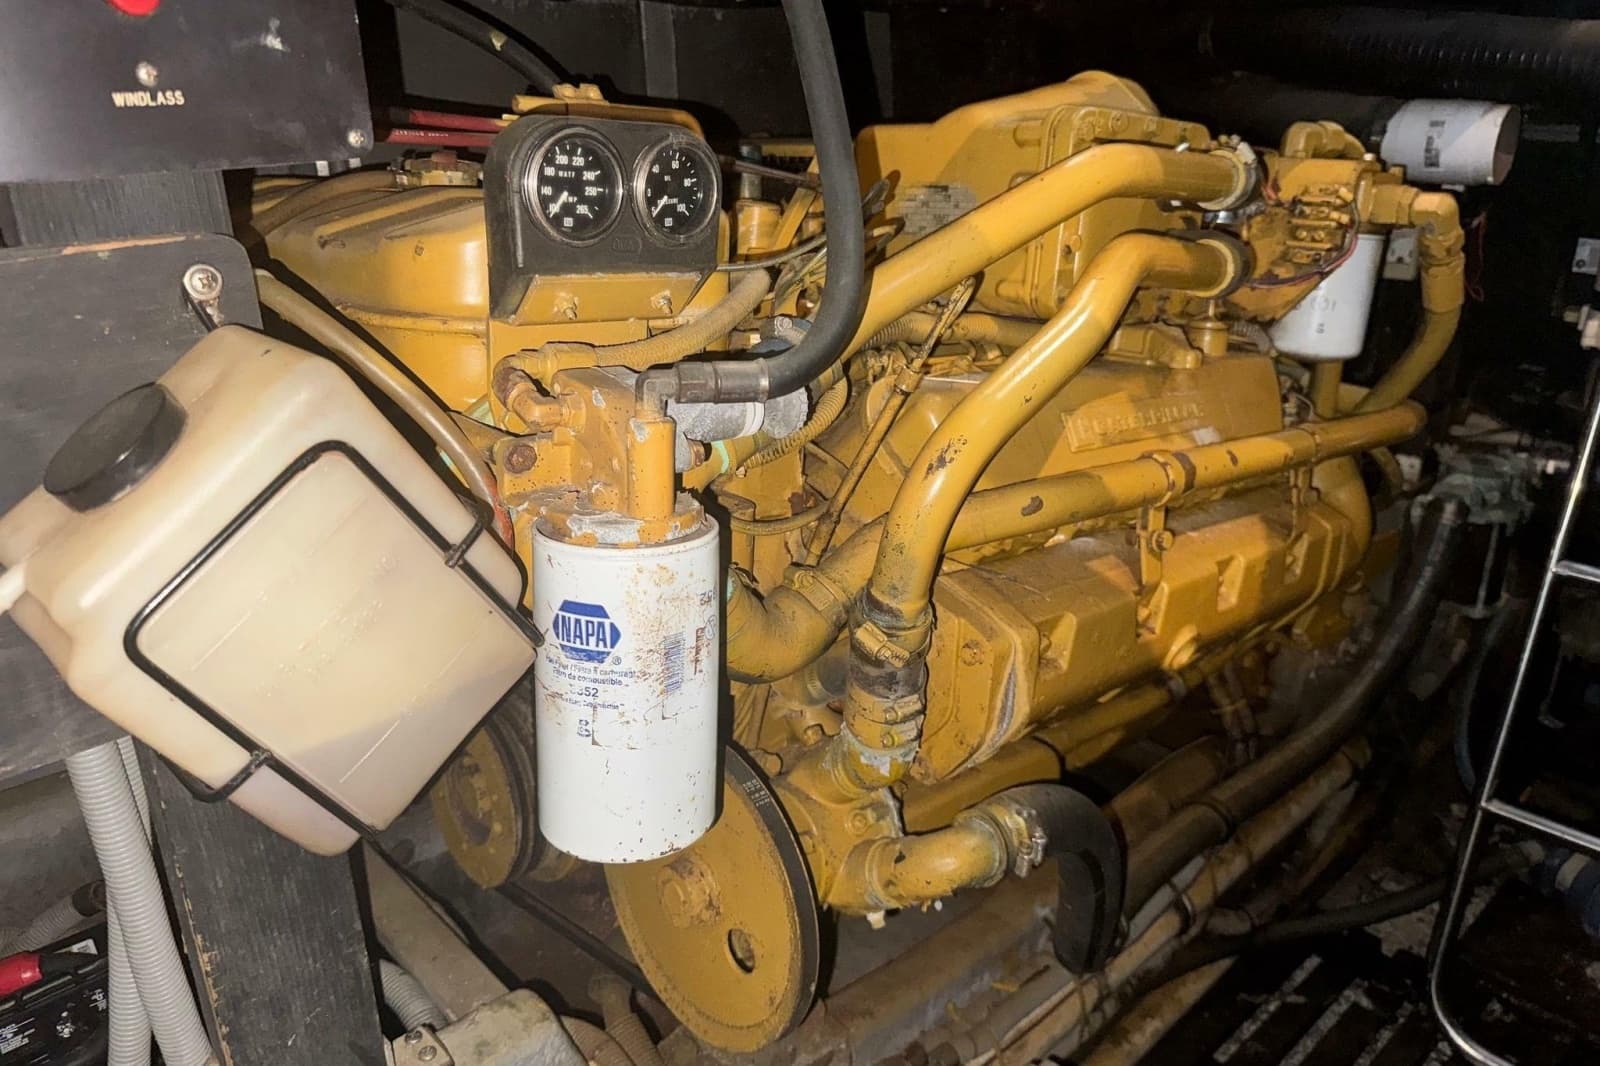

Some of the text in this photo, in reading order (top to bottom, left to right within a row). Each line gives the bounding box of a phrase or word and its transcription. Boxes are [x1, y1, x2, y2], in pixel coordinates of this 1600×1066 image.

[111, 90, 185, 107] WINDLASS
[555, 155, 585, 166] 200 220
[582, 171, 595, 181] 240
[541, 186, 552, 196] 140
[584, 186, 597, 196] 250
[576, 205, 588, 214] 265
[561, 614, 608, 650] NAPA
